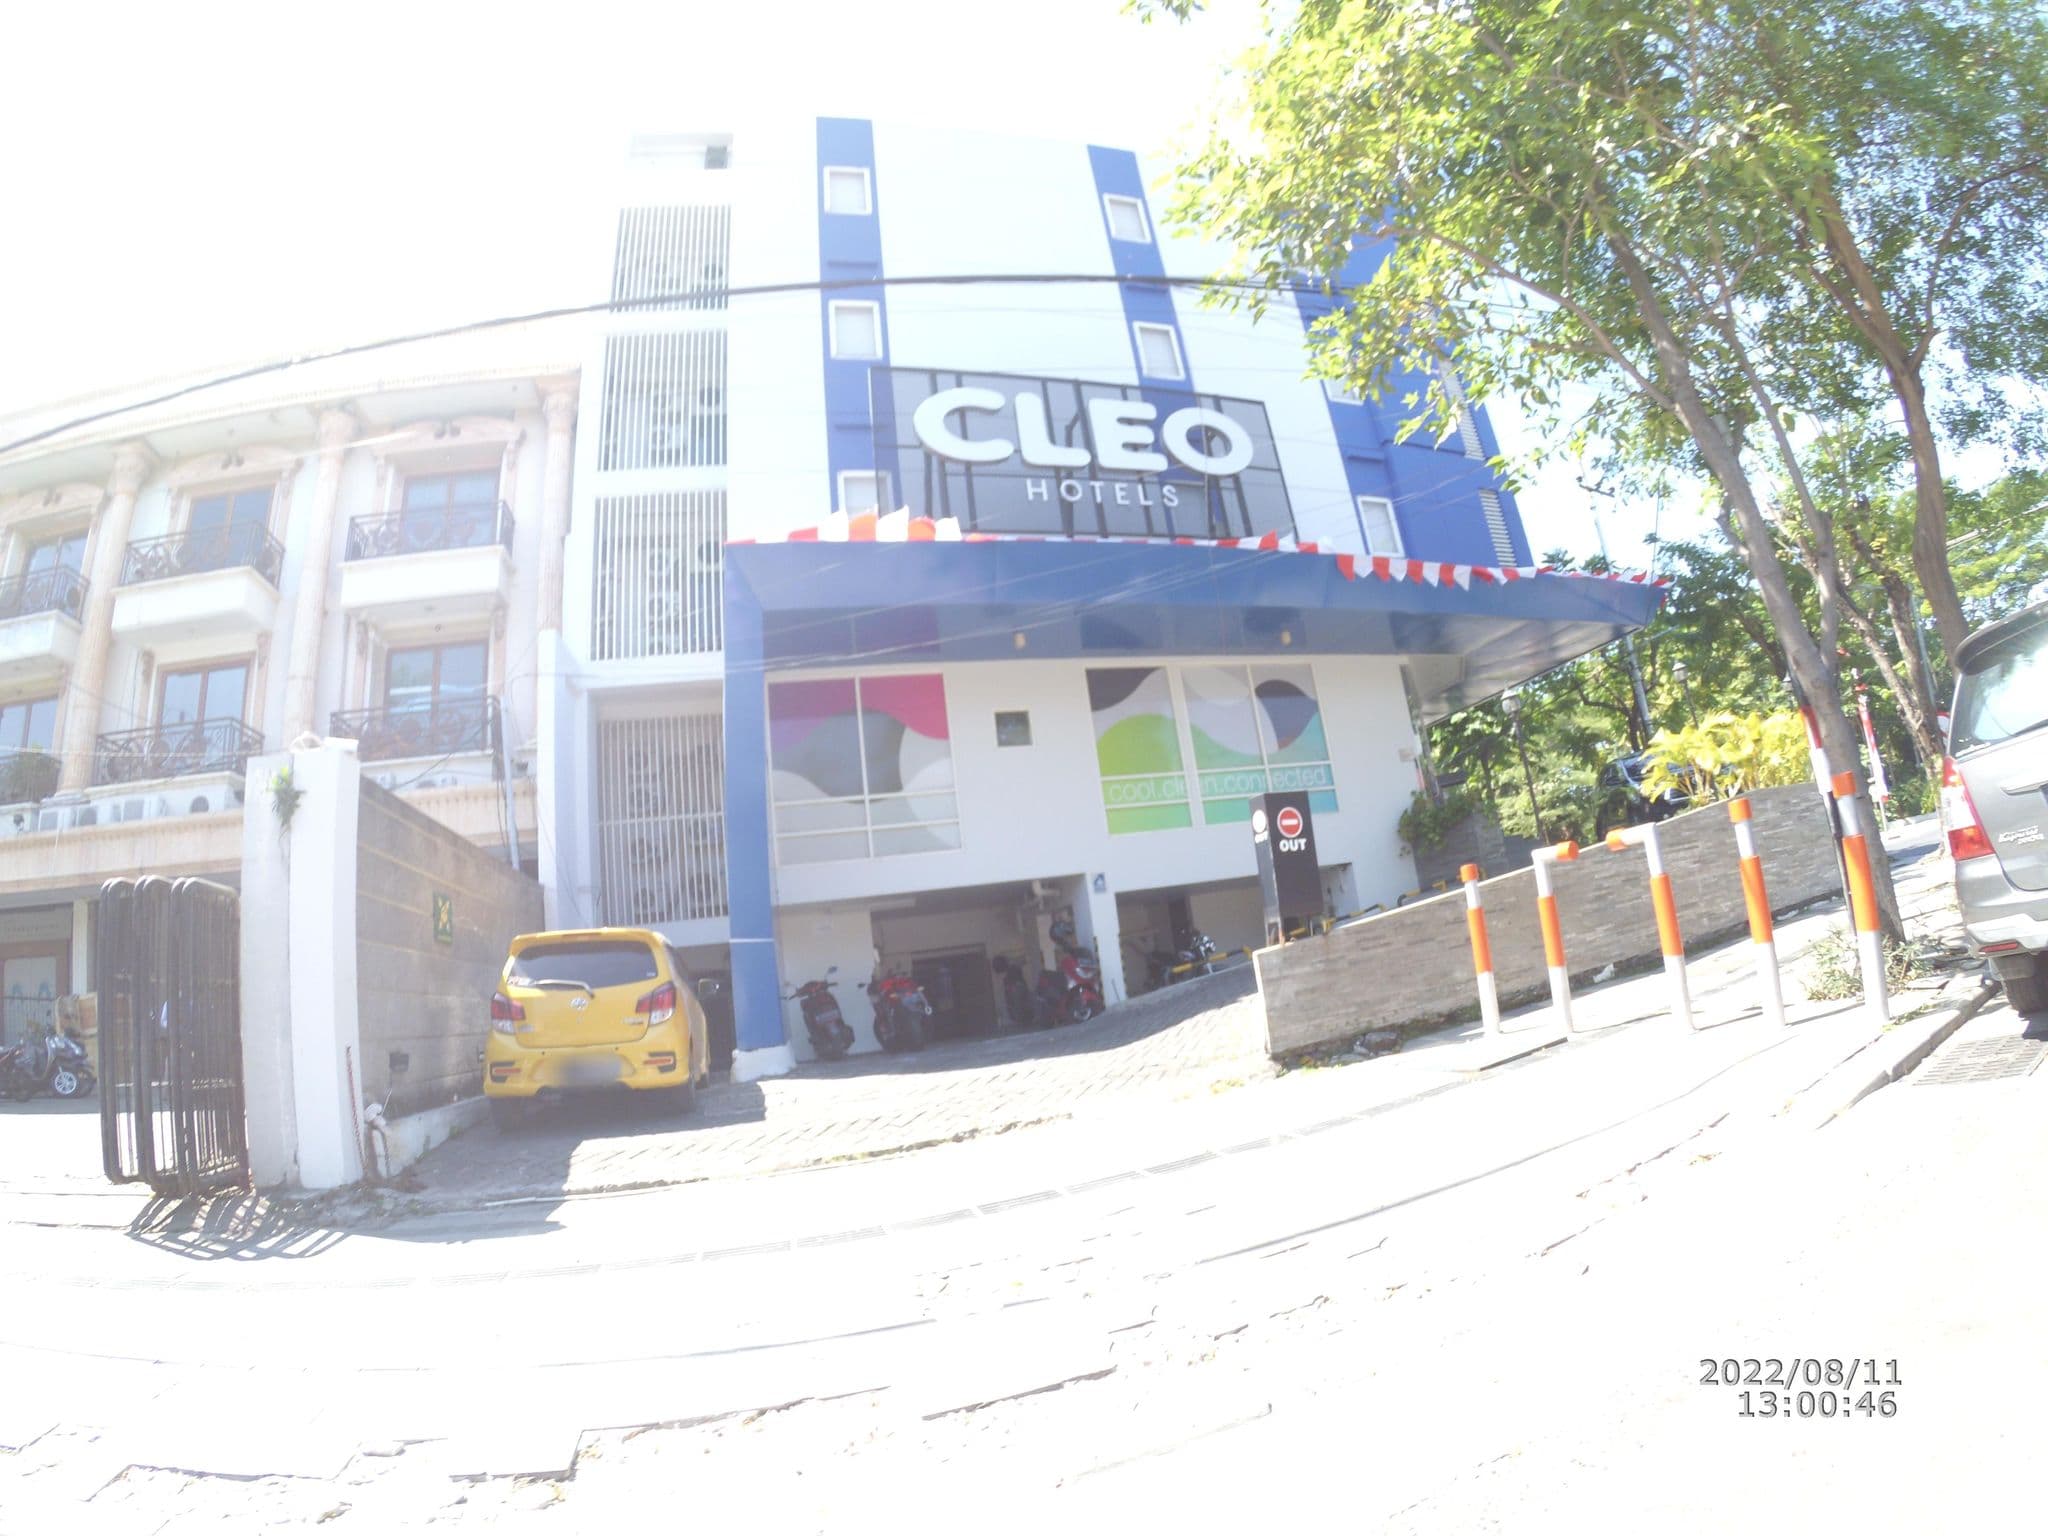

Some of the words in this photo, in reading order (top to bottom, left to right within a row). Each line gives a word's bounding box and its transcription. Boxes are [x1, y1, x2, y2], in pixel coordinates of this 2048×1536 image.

[913, 387, 1254, 476] CLEO
[1026, 479, 1178, 507] HOTELS
[1279, 838, 1307, 852] OUT
